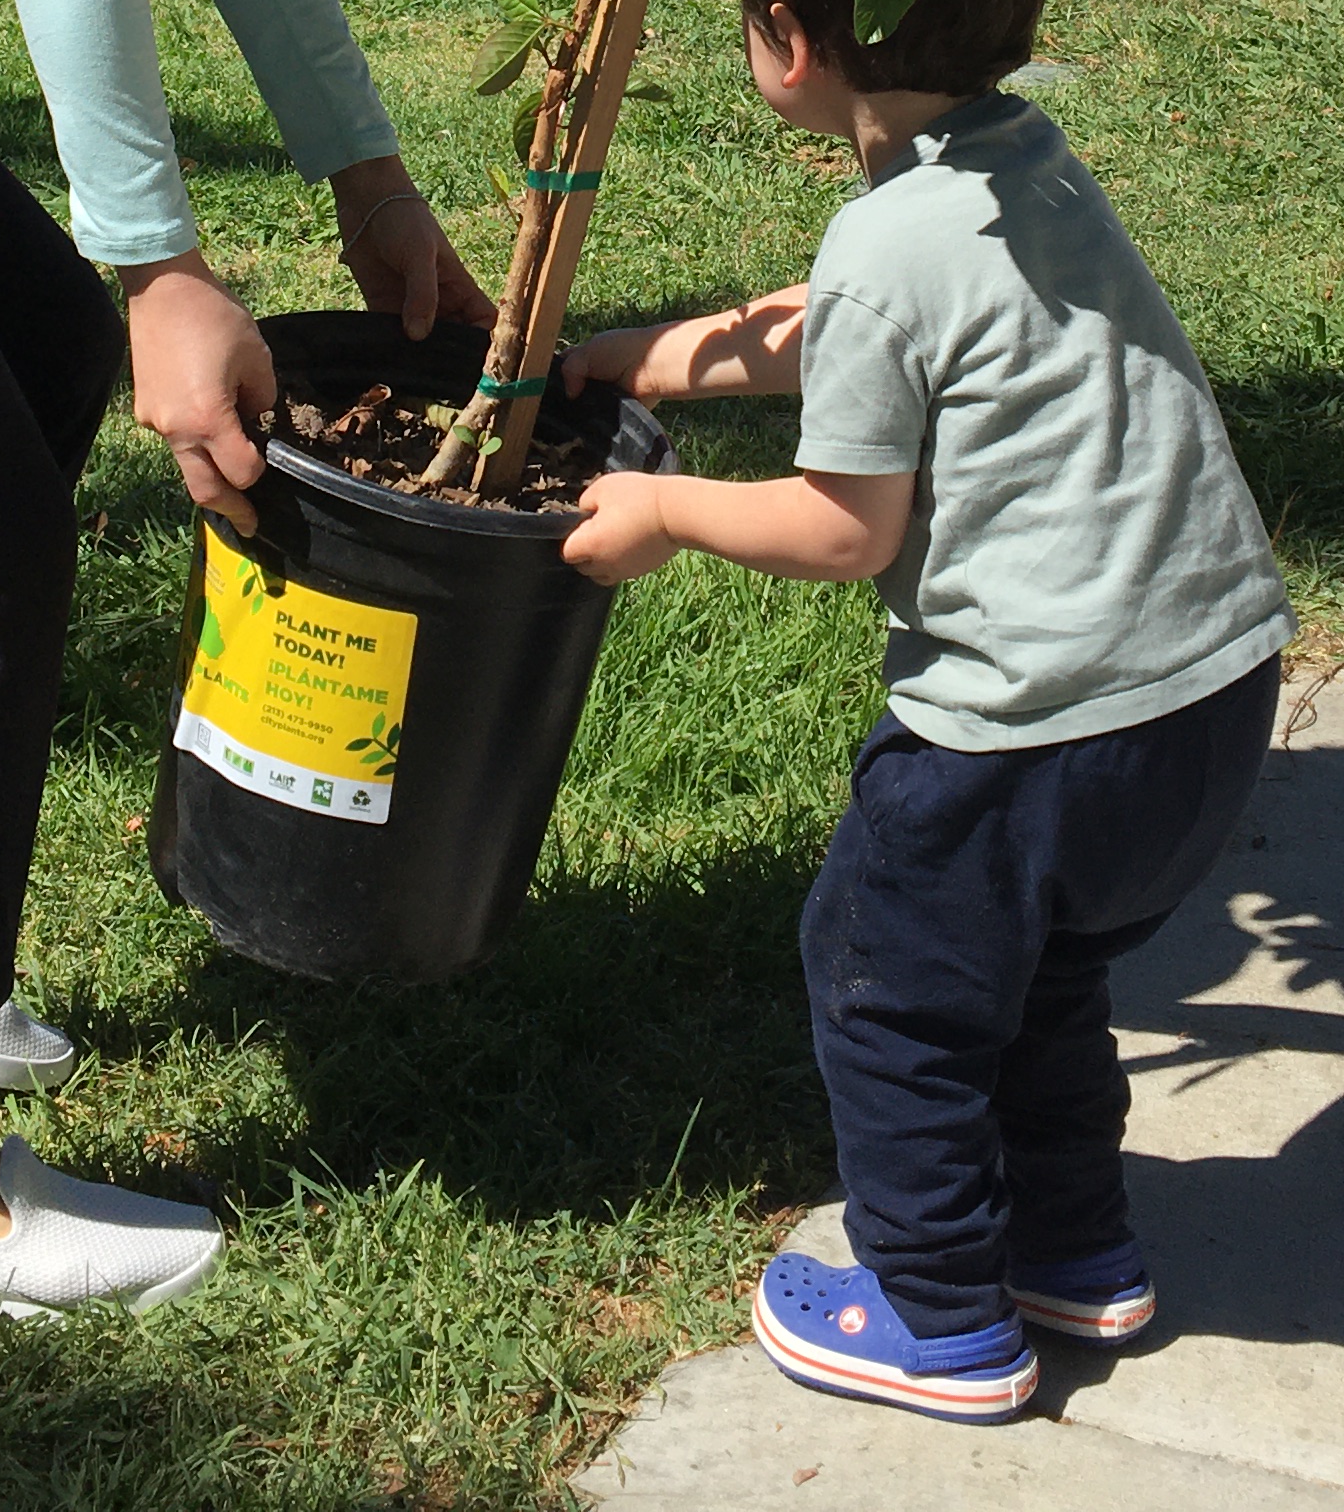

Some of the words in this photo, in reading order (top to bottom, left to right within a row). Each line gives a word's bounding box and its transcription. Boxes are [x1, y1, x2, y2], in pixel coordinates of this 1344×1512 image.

[276, 609, 341, 644] PLANT
[345, 633, 377, 653] ME
[273, 632, 345, 669] TODAY!
[265, 681, 313, 710] HOY!
[268, 659, 389, 705] ¡PLÁNTAME
[260, 715, 325, 745] cityplants.org
[262, 704, 285, 719] (213)
[287, 714, 333, 734] 473-9950
